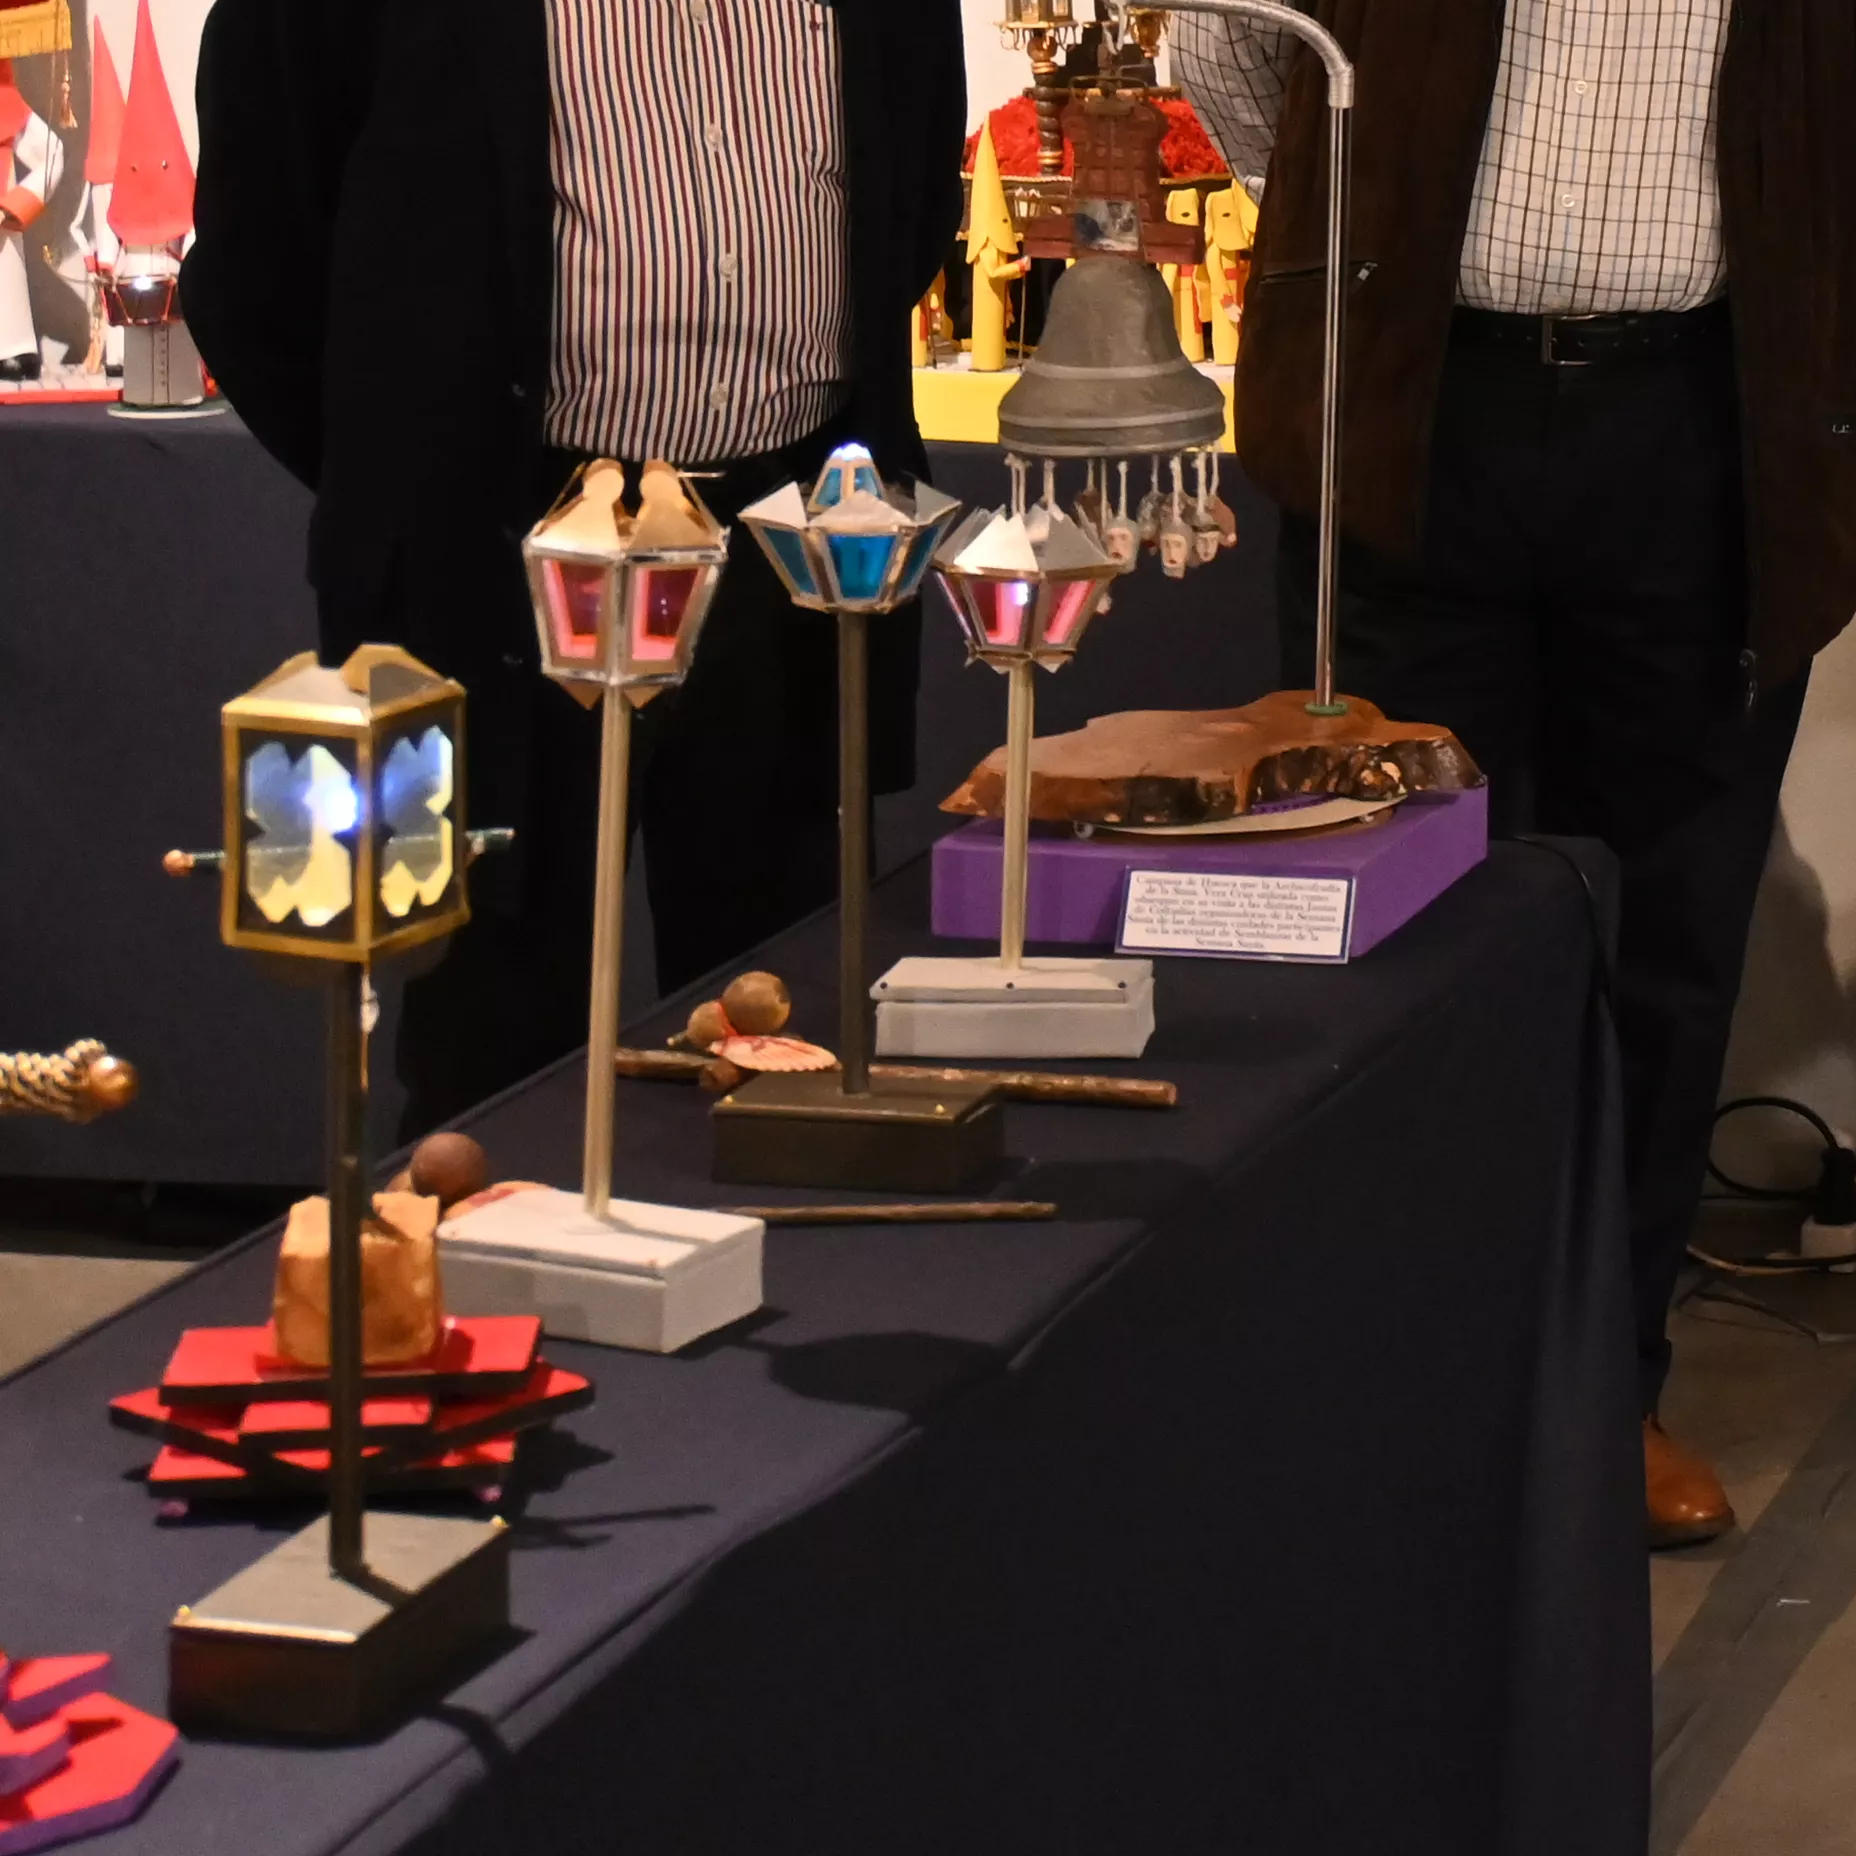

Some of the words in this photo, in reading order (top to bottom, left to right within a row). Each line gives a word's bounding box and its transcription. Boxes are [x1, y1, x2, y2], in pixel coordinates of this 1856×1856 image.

[1185, 876, 1197, 886] de
[1160, 885, 1169, 894] la
[1160, 925, 1169, 934] la
